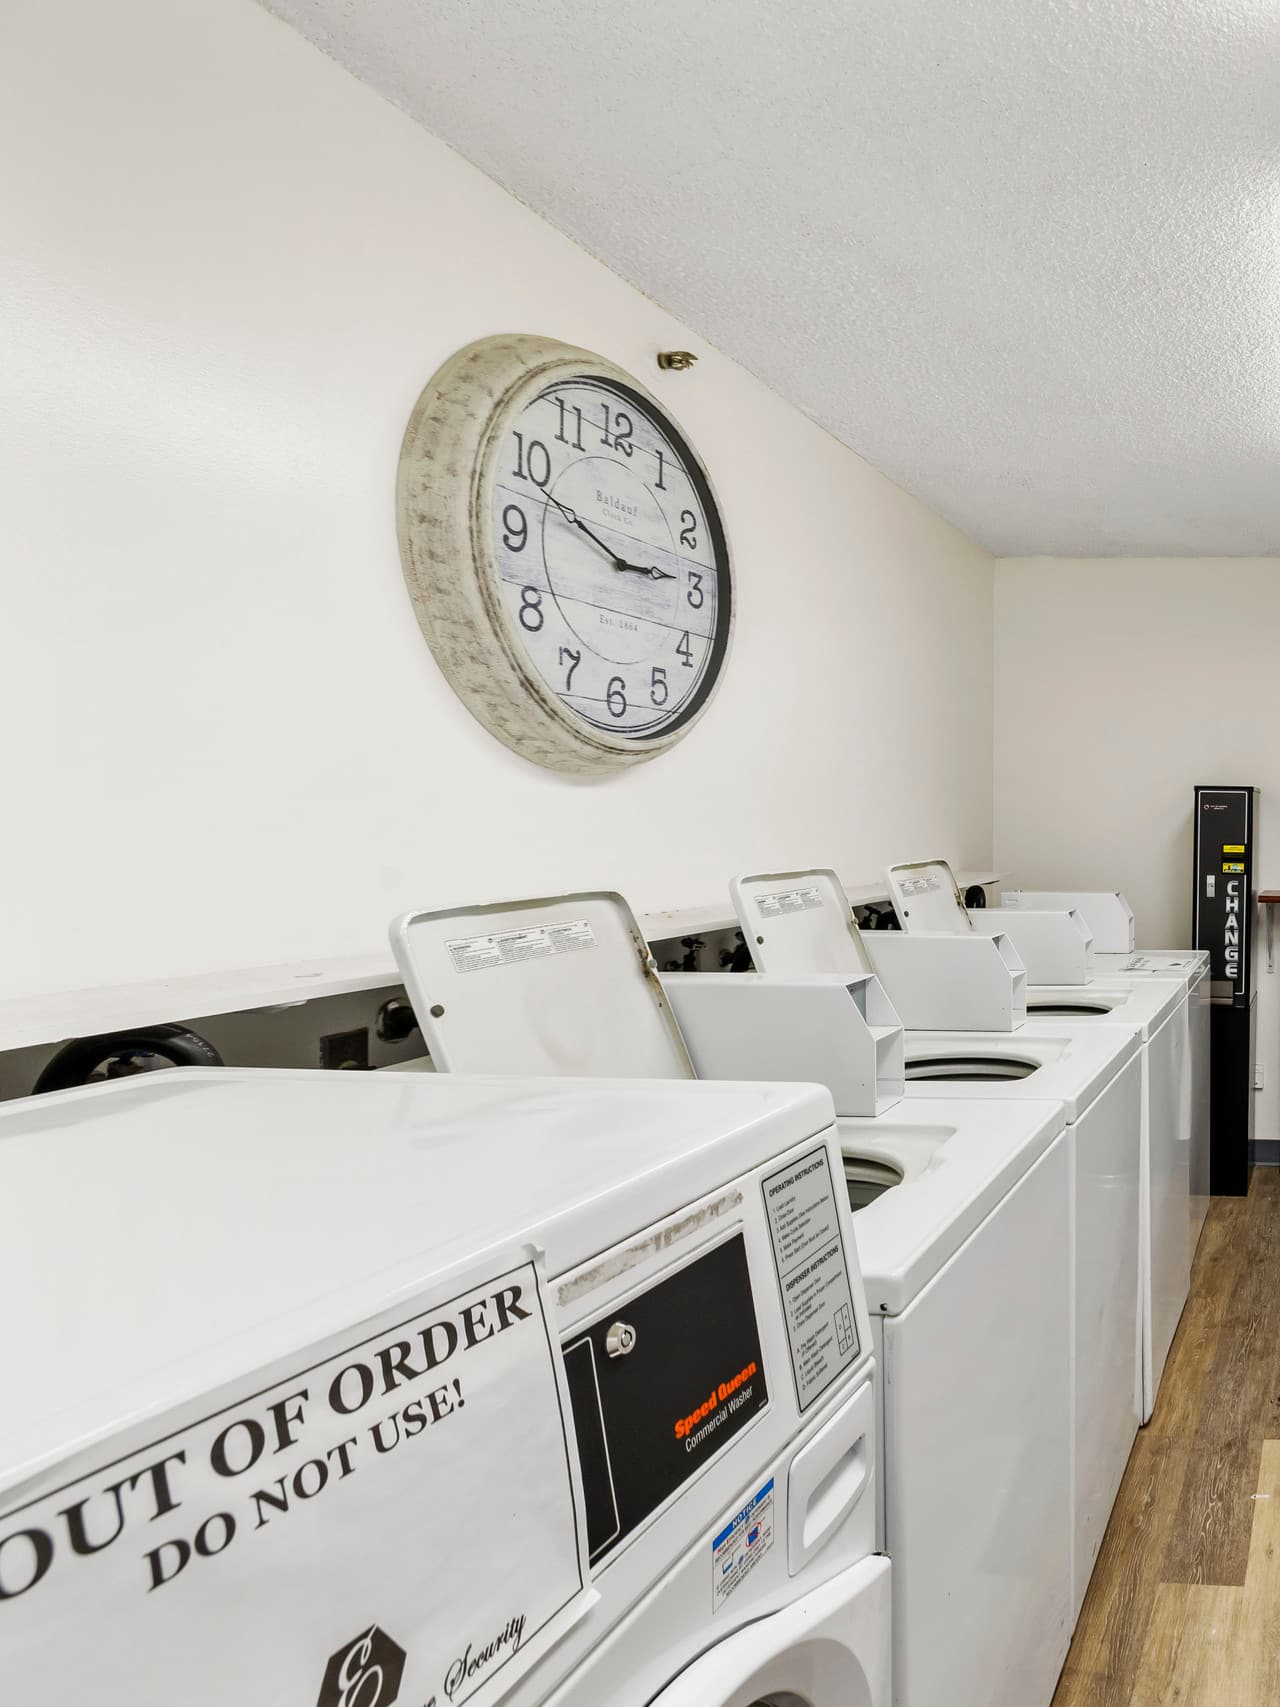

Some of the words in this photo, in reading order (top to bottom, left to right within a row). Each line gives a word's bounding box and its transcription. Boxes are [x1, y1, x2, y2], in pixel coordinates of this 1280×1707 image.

[554, 396, 585, 452] 11
[600, 403, 633, 458] 12
[512, 430, 551, 488] 10
[655, 449, 668, 491] 1
[502, 503, 528, 552] 9
[680, 509, 697, 549] 2
[519, 585, 544, 632] 8
[687, 571, 704, 609] 3
[559, 646, 581, 691] 7
[676, 631, 693, 668] 4
[607, 676, 626, 718] 6
[650, 667, 668, 705] 5
[1224, 880, 1239, 979] CHANGE
[768, 1175, 794, 1197] OPERATING
[794, 1157, 823, 1182] INSTRUCTIONS
[785, 1266, 810, 1292] DISPENSER
[810, 1244, 838, 1272] INSTRUCTIONS
[674, 1391, 718, 1439] Speed
[717, 1361, 757, 1400] Queen
[685, 1406, 728, 1453] Commercial
[728, 1385, 753, 1414] Washer
[0, 1451, 186, 1601] OUT
[210, 1388, 309, 1478] OF
[328, 1284, 533, 1415] ORDER
[142, 1511, 237, 1594] DO
[249, 1438, 358, 1531] NOT
[368, 1378, 466, 1454] USE!
[732, 1497, 758, 1529] NOTICE
[444, 1613, 527, 1702] Security
